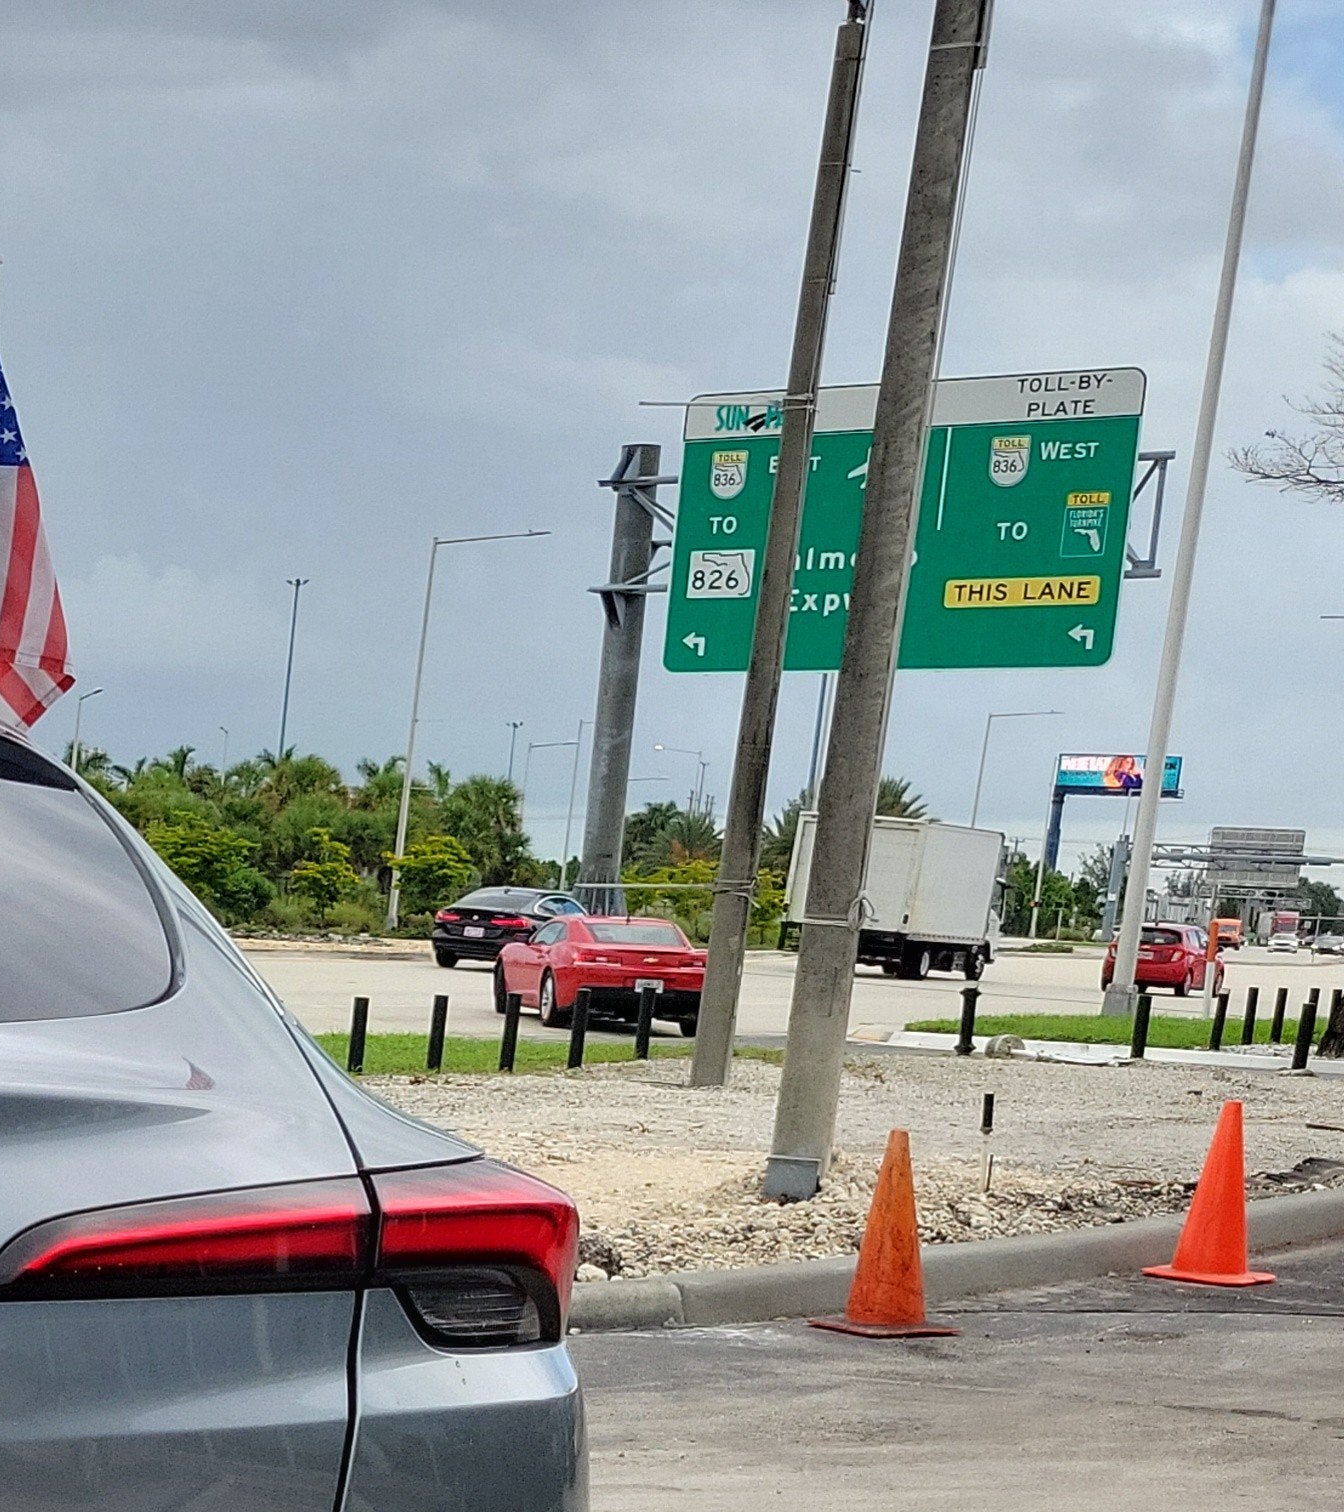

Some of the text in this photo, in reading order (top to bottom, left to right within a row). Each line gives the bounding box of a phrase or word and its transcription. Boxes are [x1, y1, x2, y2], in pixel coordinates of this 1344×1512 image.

[1026, 399, 1095, 418] PLATE
[997, 439, 1025, 448] TOLL
[992, 441, 1099, 474] 836 WEST
[713, 473, 736, 487] 836
[1072, 494, 1105, 504] TOLL
[709, 516, 737, 534] TO
[997, 522, 1028, 540] TO
[692, 569, 739, 590] 826
[954, 580, 1092, 602] THIS LANE
